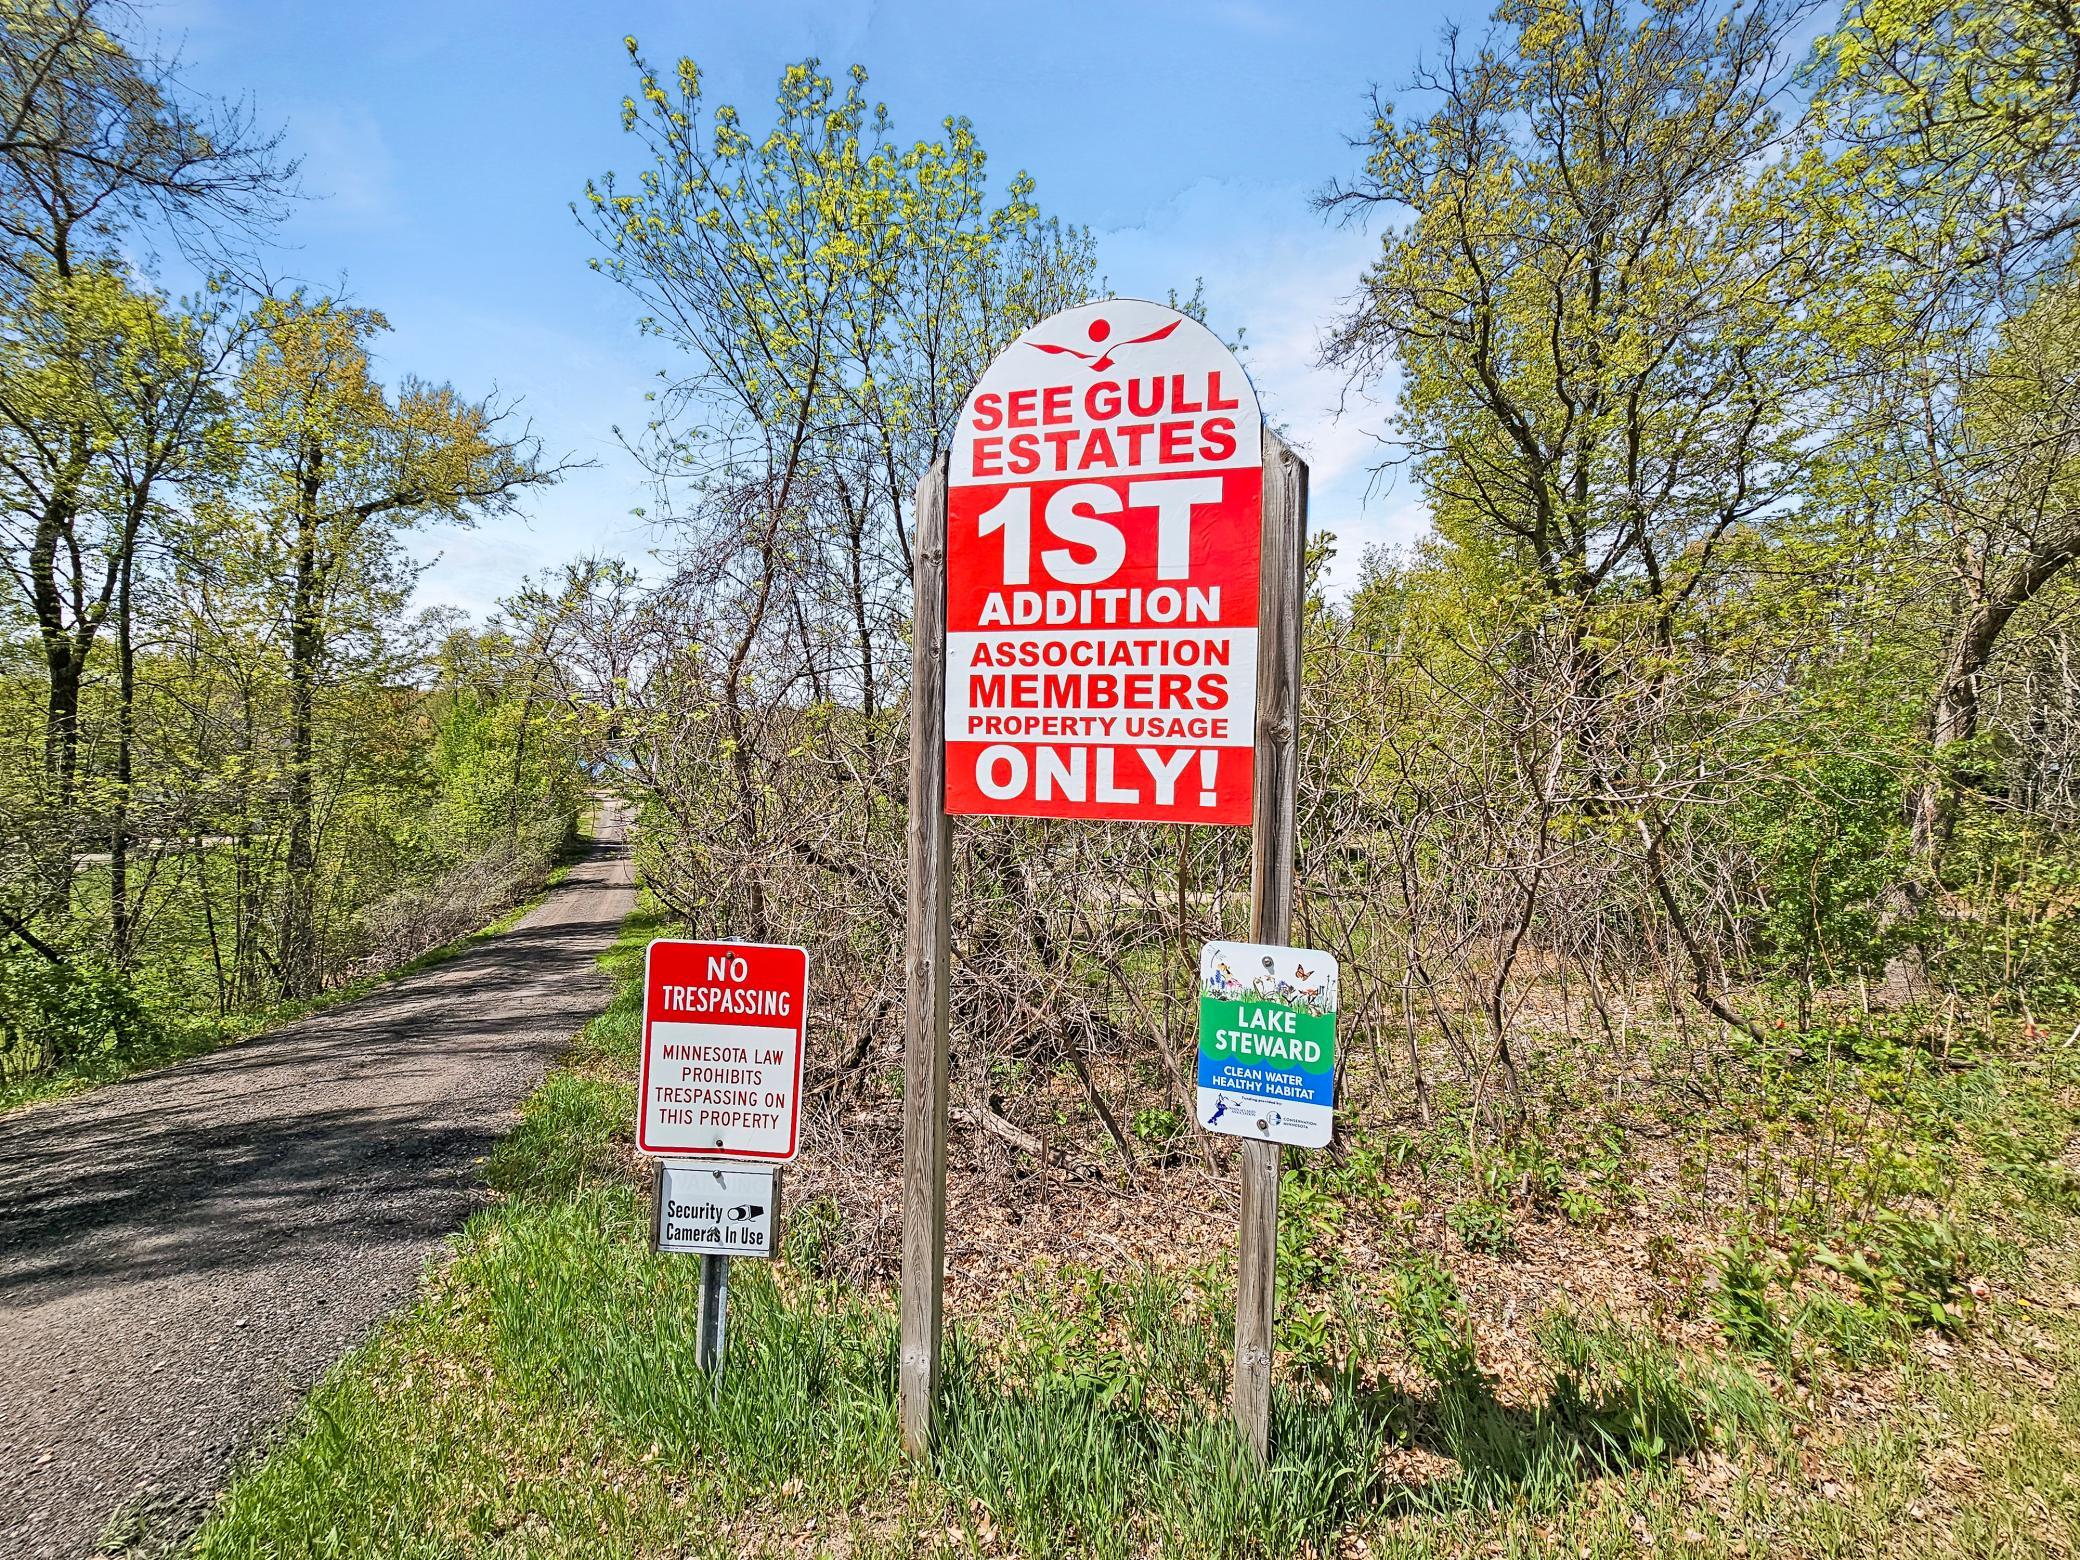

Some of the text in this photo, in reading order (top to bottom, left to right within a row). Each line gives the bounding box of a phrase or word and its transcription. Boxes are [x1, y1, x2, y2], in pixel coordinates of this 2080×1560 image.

[972, 371, 1239, 432] SEE GULL
[972, 417, 1237, 476] ESTATES
[978, 477, 1222, 585] 1ST
[978, 586, 1220, 626] ADDITION
[970, 640, 1229, 668] ASSOCIATION
[969, 674, 1229, 710] MEMBERS
[968, 715, 1228, 738] PROPERTY USAGE
[975, 745, 1219, 807] ONLY!
[707, 957, 748, 982] NO
[662, 985, 790, 1017] TRESPASSING
[1238, 1006, 1297, 1034] LAKE
[663, 1045, 783, 1065] MINNESOTA LAW
[1215, 1029, 1321, 1063] STEWARD
[682, 1067, 762, 1085] PROHIBITS
[1212, 1075, 1315, 1100] HEALTHY HABITAT
[1223, 1065, 1303, 1087] CLEAN WATER
[656, 1087, 785, 1108] TRESPASSING ON
[659, 1109, 780, 1129] THIS PROPERTY
[667, 1200, 722, 1223] Security
[666, 1223, 764, 1246] Cameras In Use
